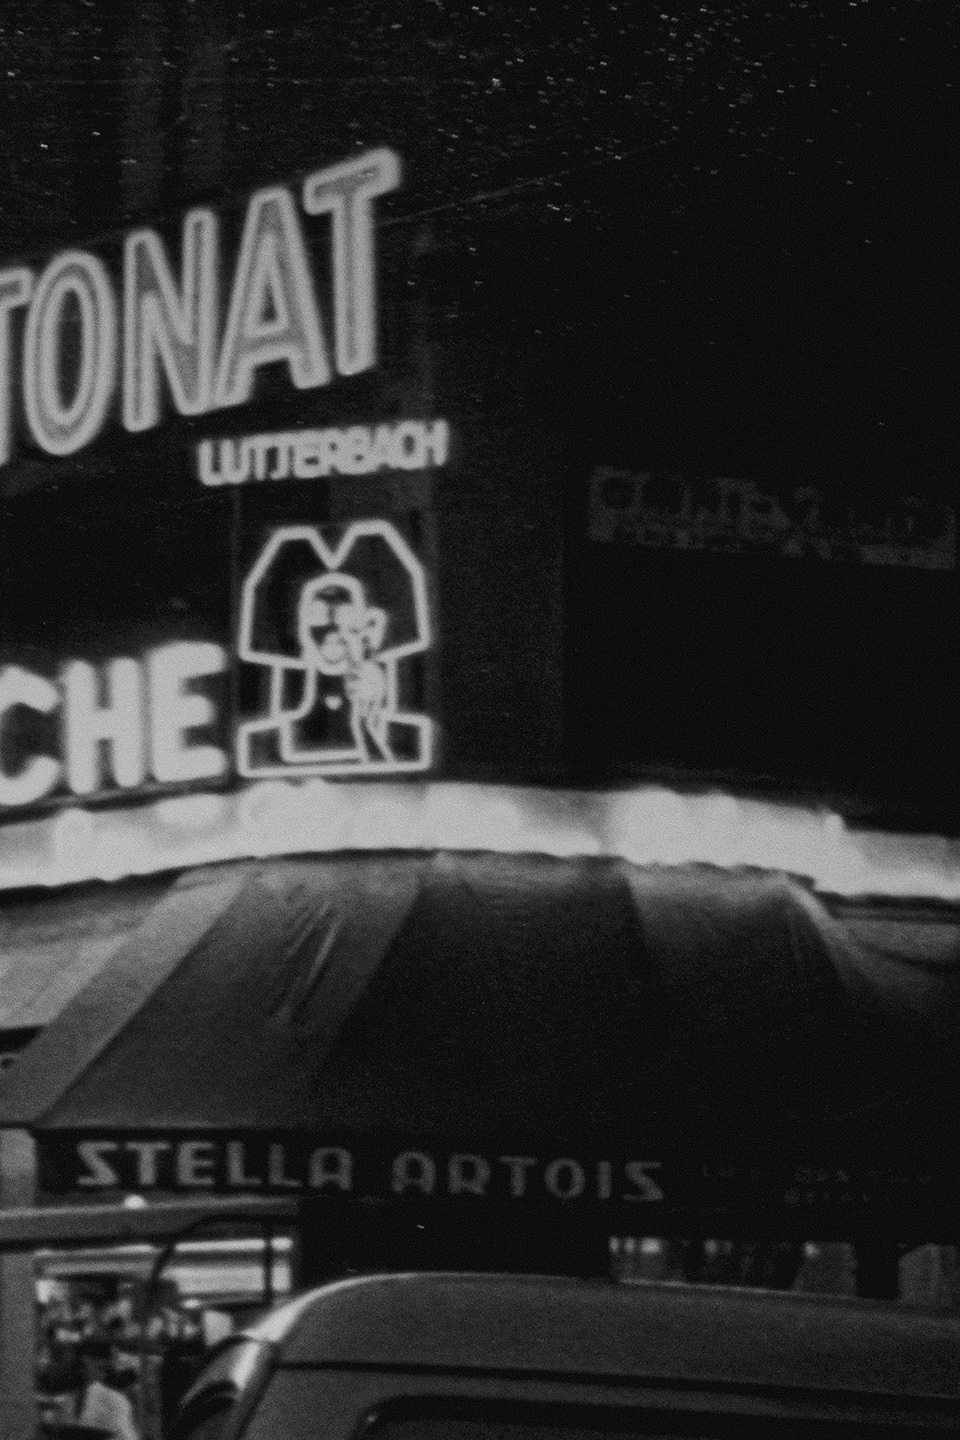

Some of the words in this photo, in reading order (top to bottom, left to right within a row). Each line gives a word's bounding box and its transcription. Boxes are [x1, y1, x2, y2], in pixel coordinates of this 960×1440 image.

[196, 418, 450, 487] LUTTERBACH
[76, 1139, 354, 1191] STELLA
[391, 1150, 666, 1202] ARTOIS
